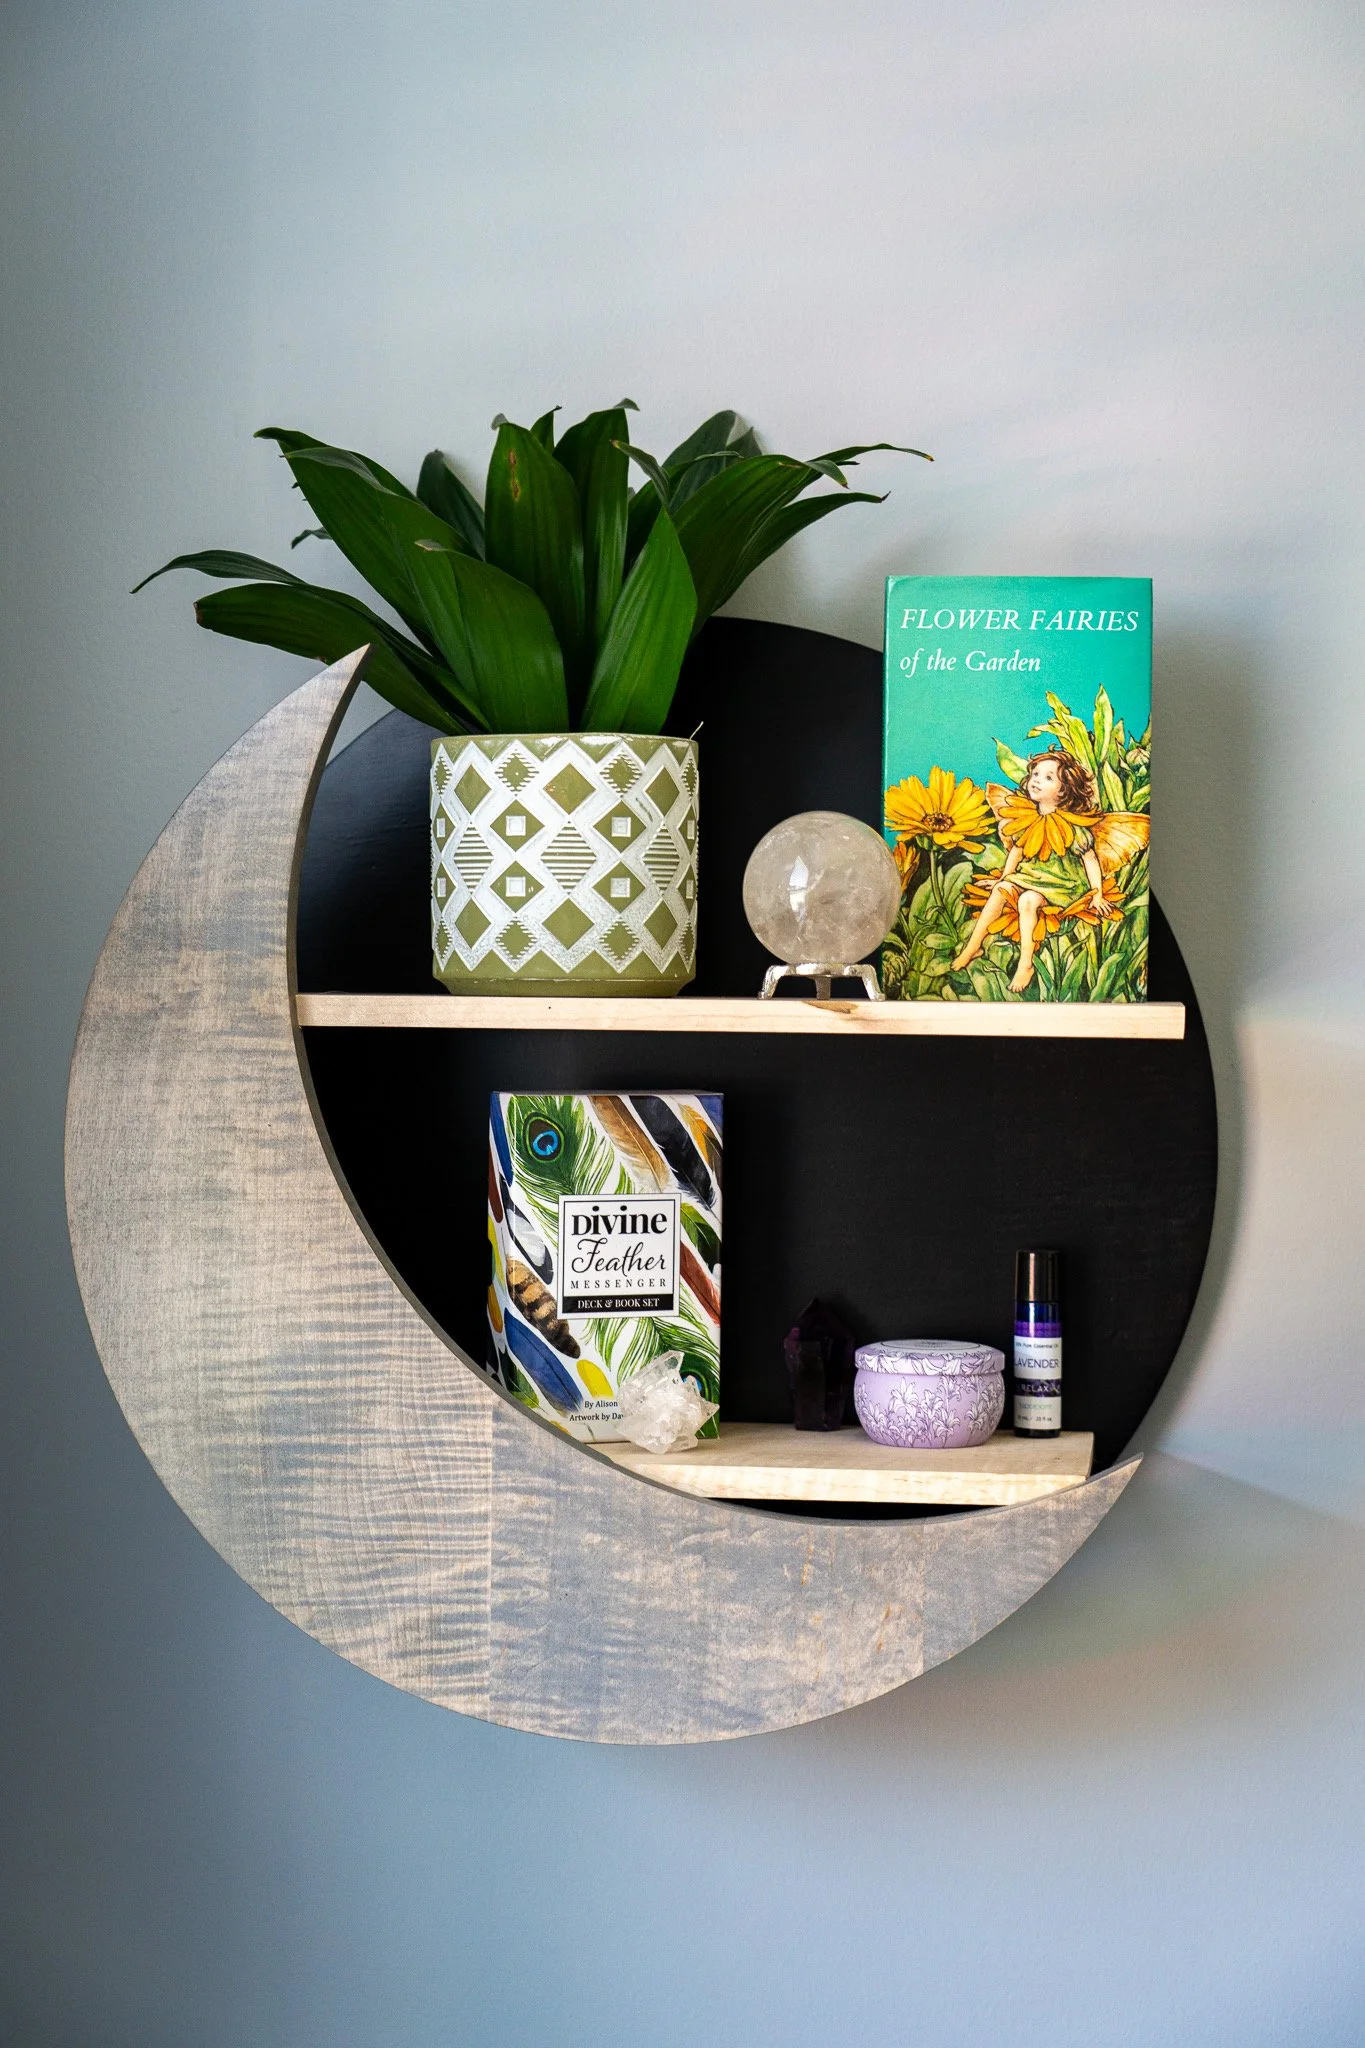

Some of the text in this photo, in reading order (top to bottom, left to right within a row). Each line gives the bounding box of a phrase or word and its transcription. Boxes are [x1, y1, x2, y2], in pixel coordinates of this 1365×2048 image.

[901, 608, 1139, 631] FLOWER FAIRIES
[899, 647, 1041, 678] of the Garden
[571, 1205, 668, 1235] Divine
[571, 1237, 666, 1277] Feather
[570, 1278, 667, 1289] MESSENGER
[577, 1297, 660, 1309] DECK & BOOK SET
[1021, 1383, 1049, 1393] RELAX
[584, 1400, 618, 1409] By Alison
[569, 1413, 600, 1421] Artwork
[601, 1413, 610, 1421] by
